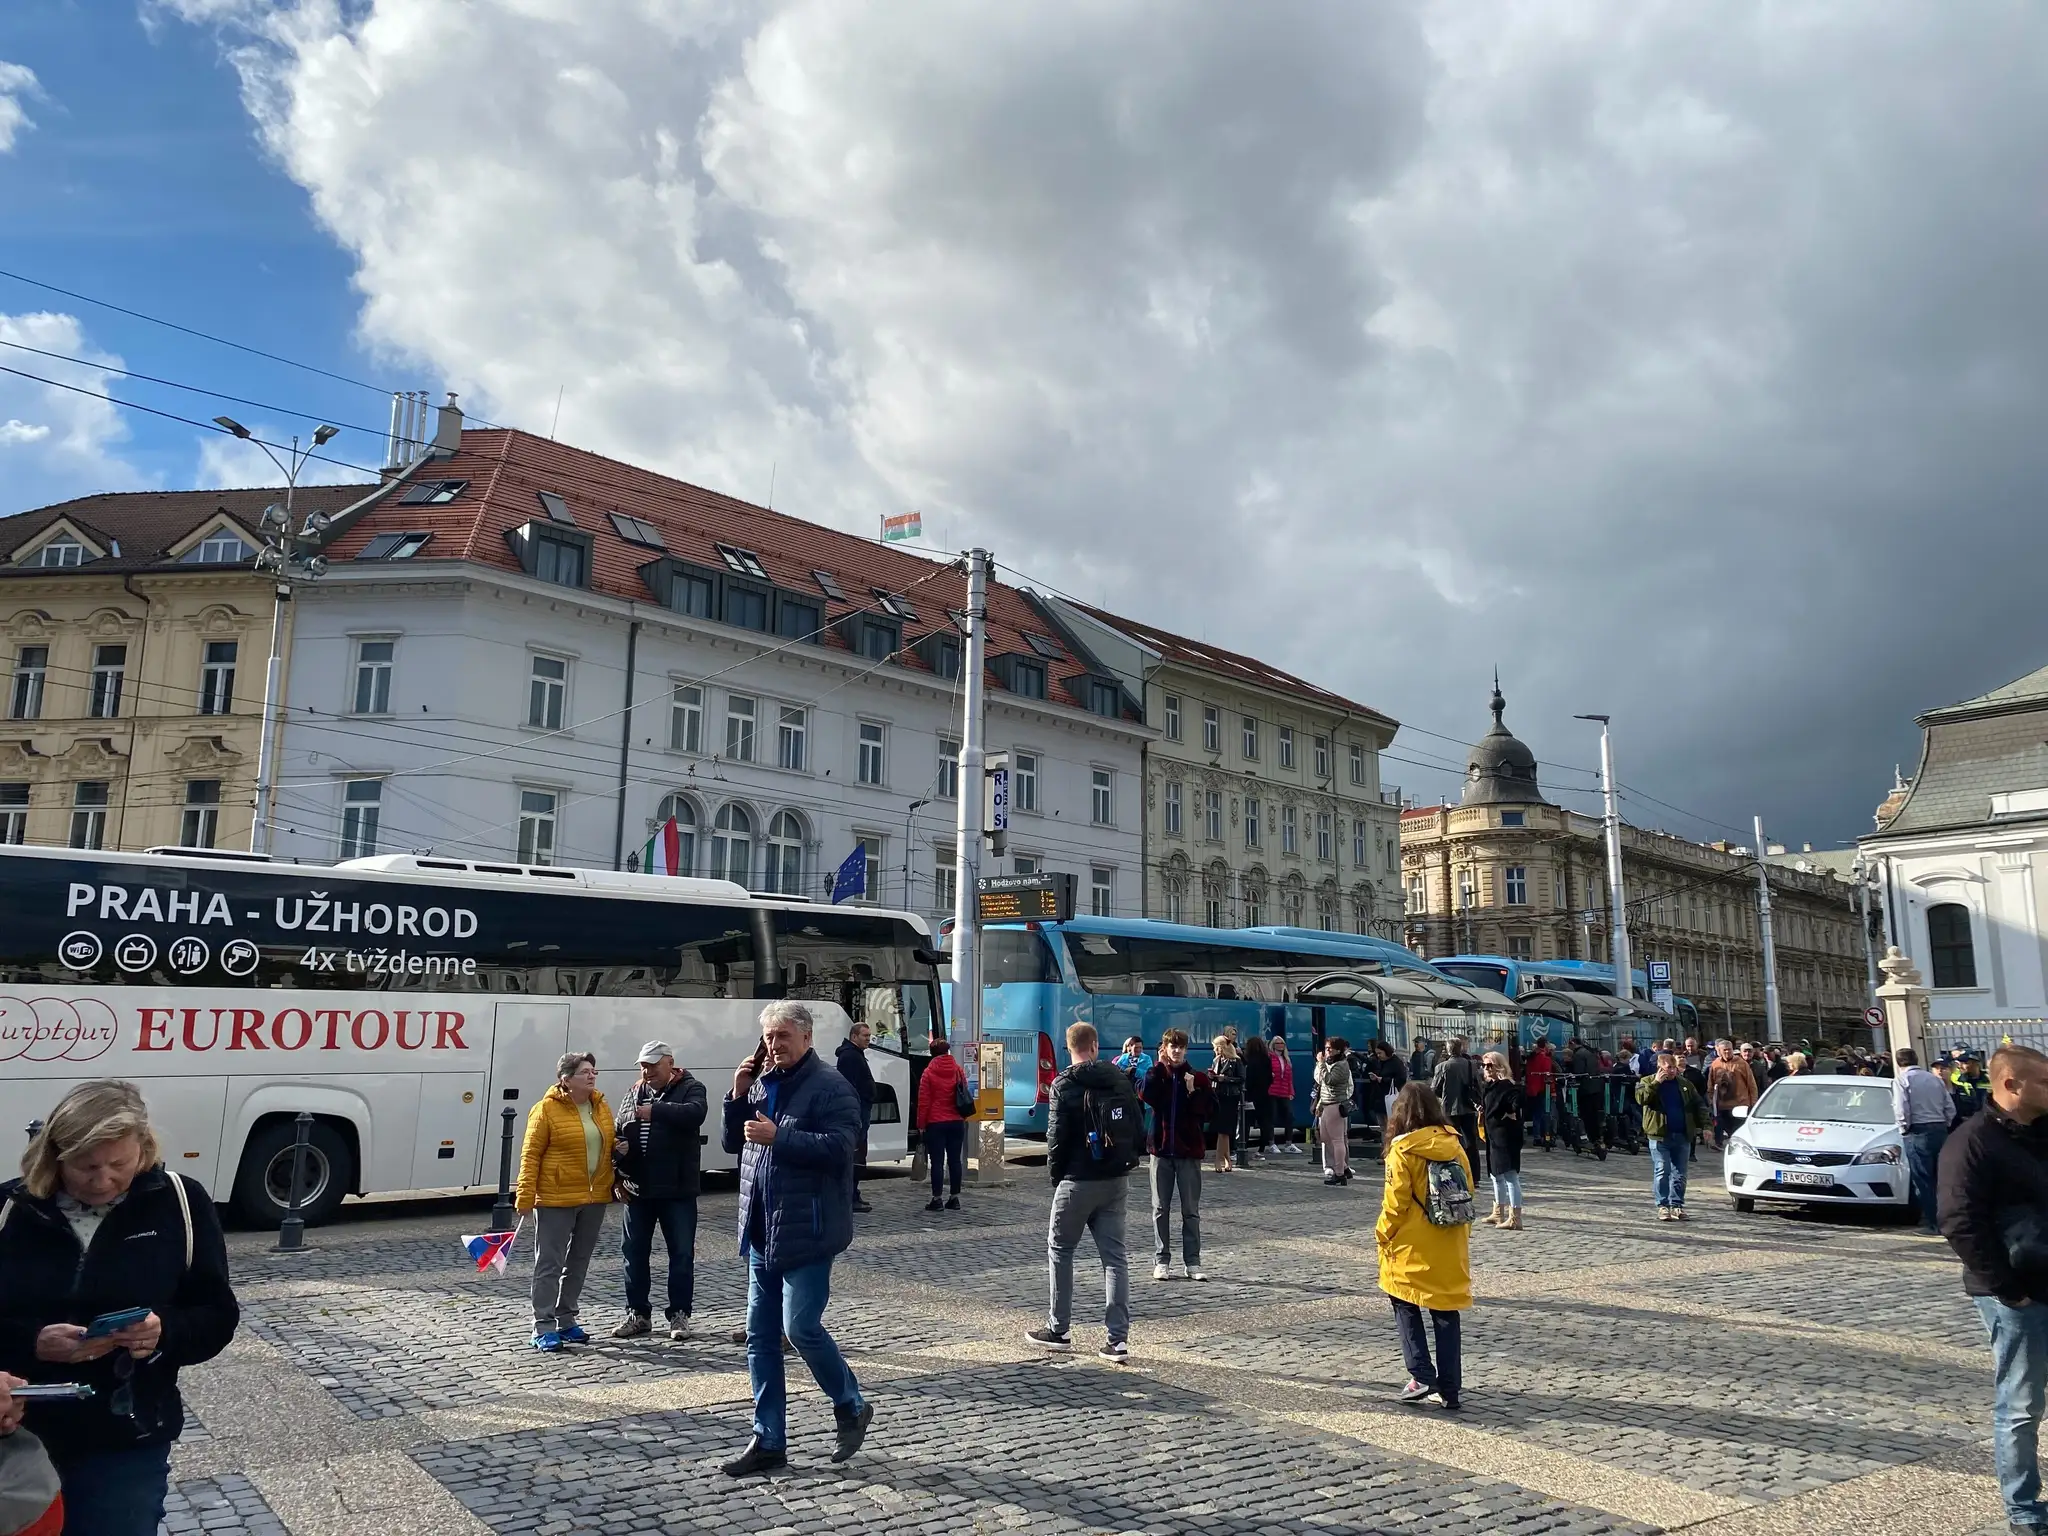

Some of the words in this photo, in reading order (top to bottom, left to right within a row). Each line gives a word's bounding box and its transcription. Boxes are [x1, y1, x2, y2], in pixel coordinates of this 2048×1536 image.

[991, 878, 1021, 888] Hodžovo
[66, 882, 234, 927] PRAHA
[246, 911, 260, 919] -
[275, 890, 478, 938] UŽHOROD
[300, 947, 335, 972] 4x
[345, 948, 477, 976] týždenne
[0, 1010, 111, 1041] urotour
[132, 1008, 470, 1051] EUROTOUR
